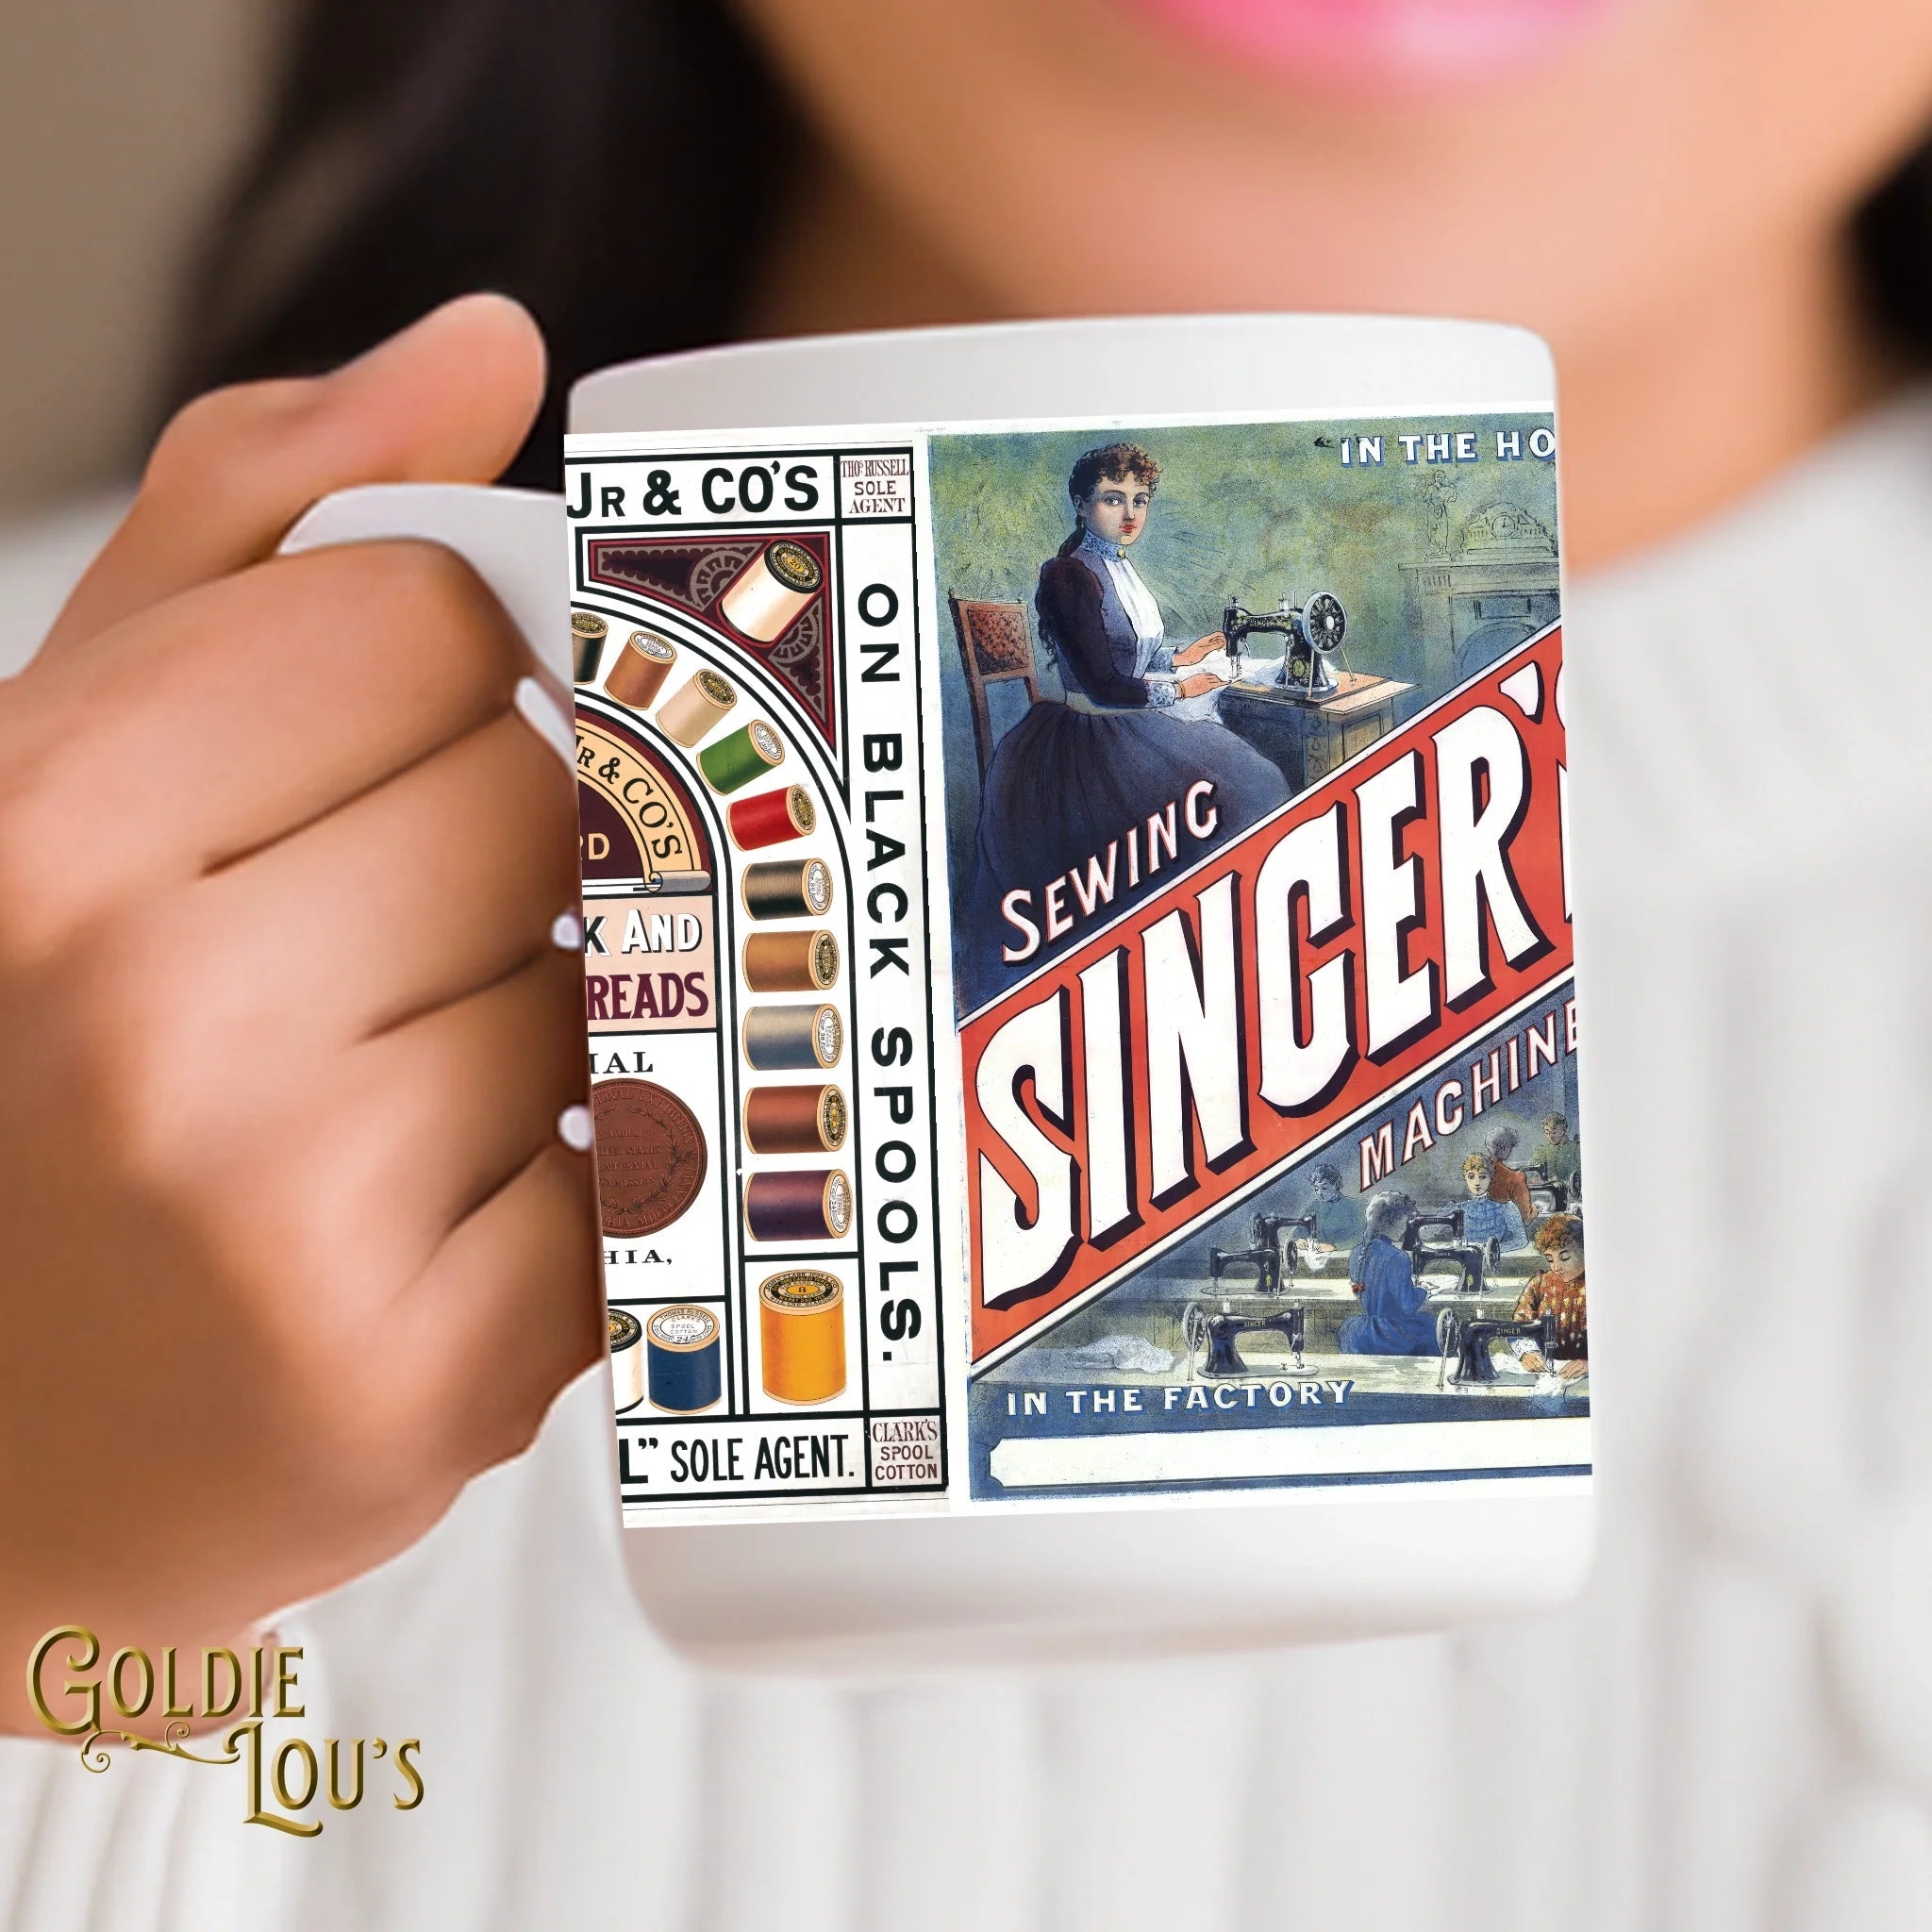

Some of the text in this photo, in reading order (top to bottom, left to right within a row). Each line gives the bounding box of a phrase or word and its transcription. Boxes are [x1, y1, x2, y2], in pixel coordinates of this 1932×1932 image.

[864, 458, 909, 477] RUSSELL
[1340, 435, 1384, 468] IN
[1398, 432, 1479, 464] THE
[642, 469, 682, 516] &
[701, 459, 820, 514] CO'S
[848, 497, 906, 514] AGENT
[854, 480, 896, 496] SOLE
[598, 757, 621, 784] &
[623, 777, 683, 858] CO'S
[1001, 778, 1221, 964] SEWING
[621, 908, 703, 955] AND
[857, 583, 922, 1361] ON BLACK SPOOLS.
[974, 660, 1573, 1309] SINGER'
[586, 972, 709, 1021] READS
[659, 1308, 712, 1324] THOMAS RUSSELL
[1006, 1379, 1356, 1417] IN THE FACTORY
[873, 1419, 938, 1442] CLARK'S
[670, 1438, 744, 1483] SOLE
[754, 1434, 855, 1481] AGENT.
[880, 1444, 934, 1461] SPOOL
[874, 1463, 938, 1481] COTTON
